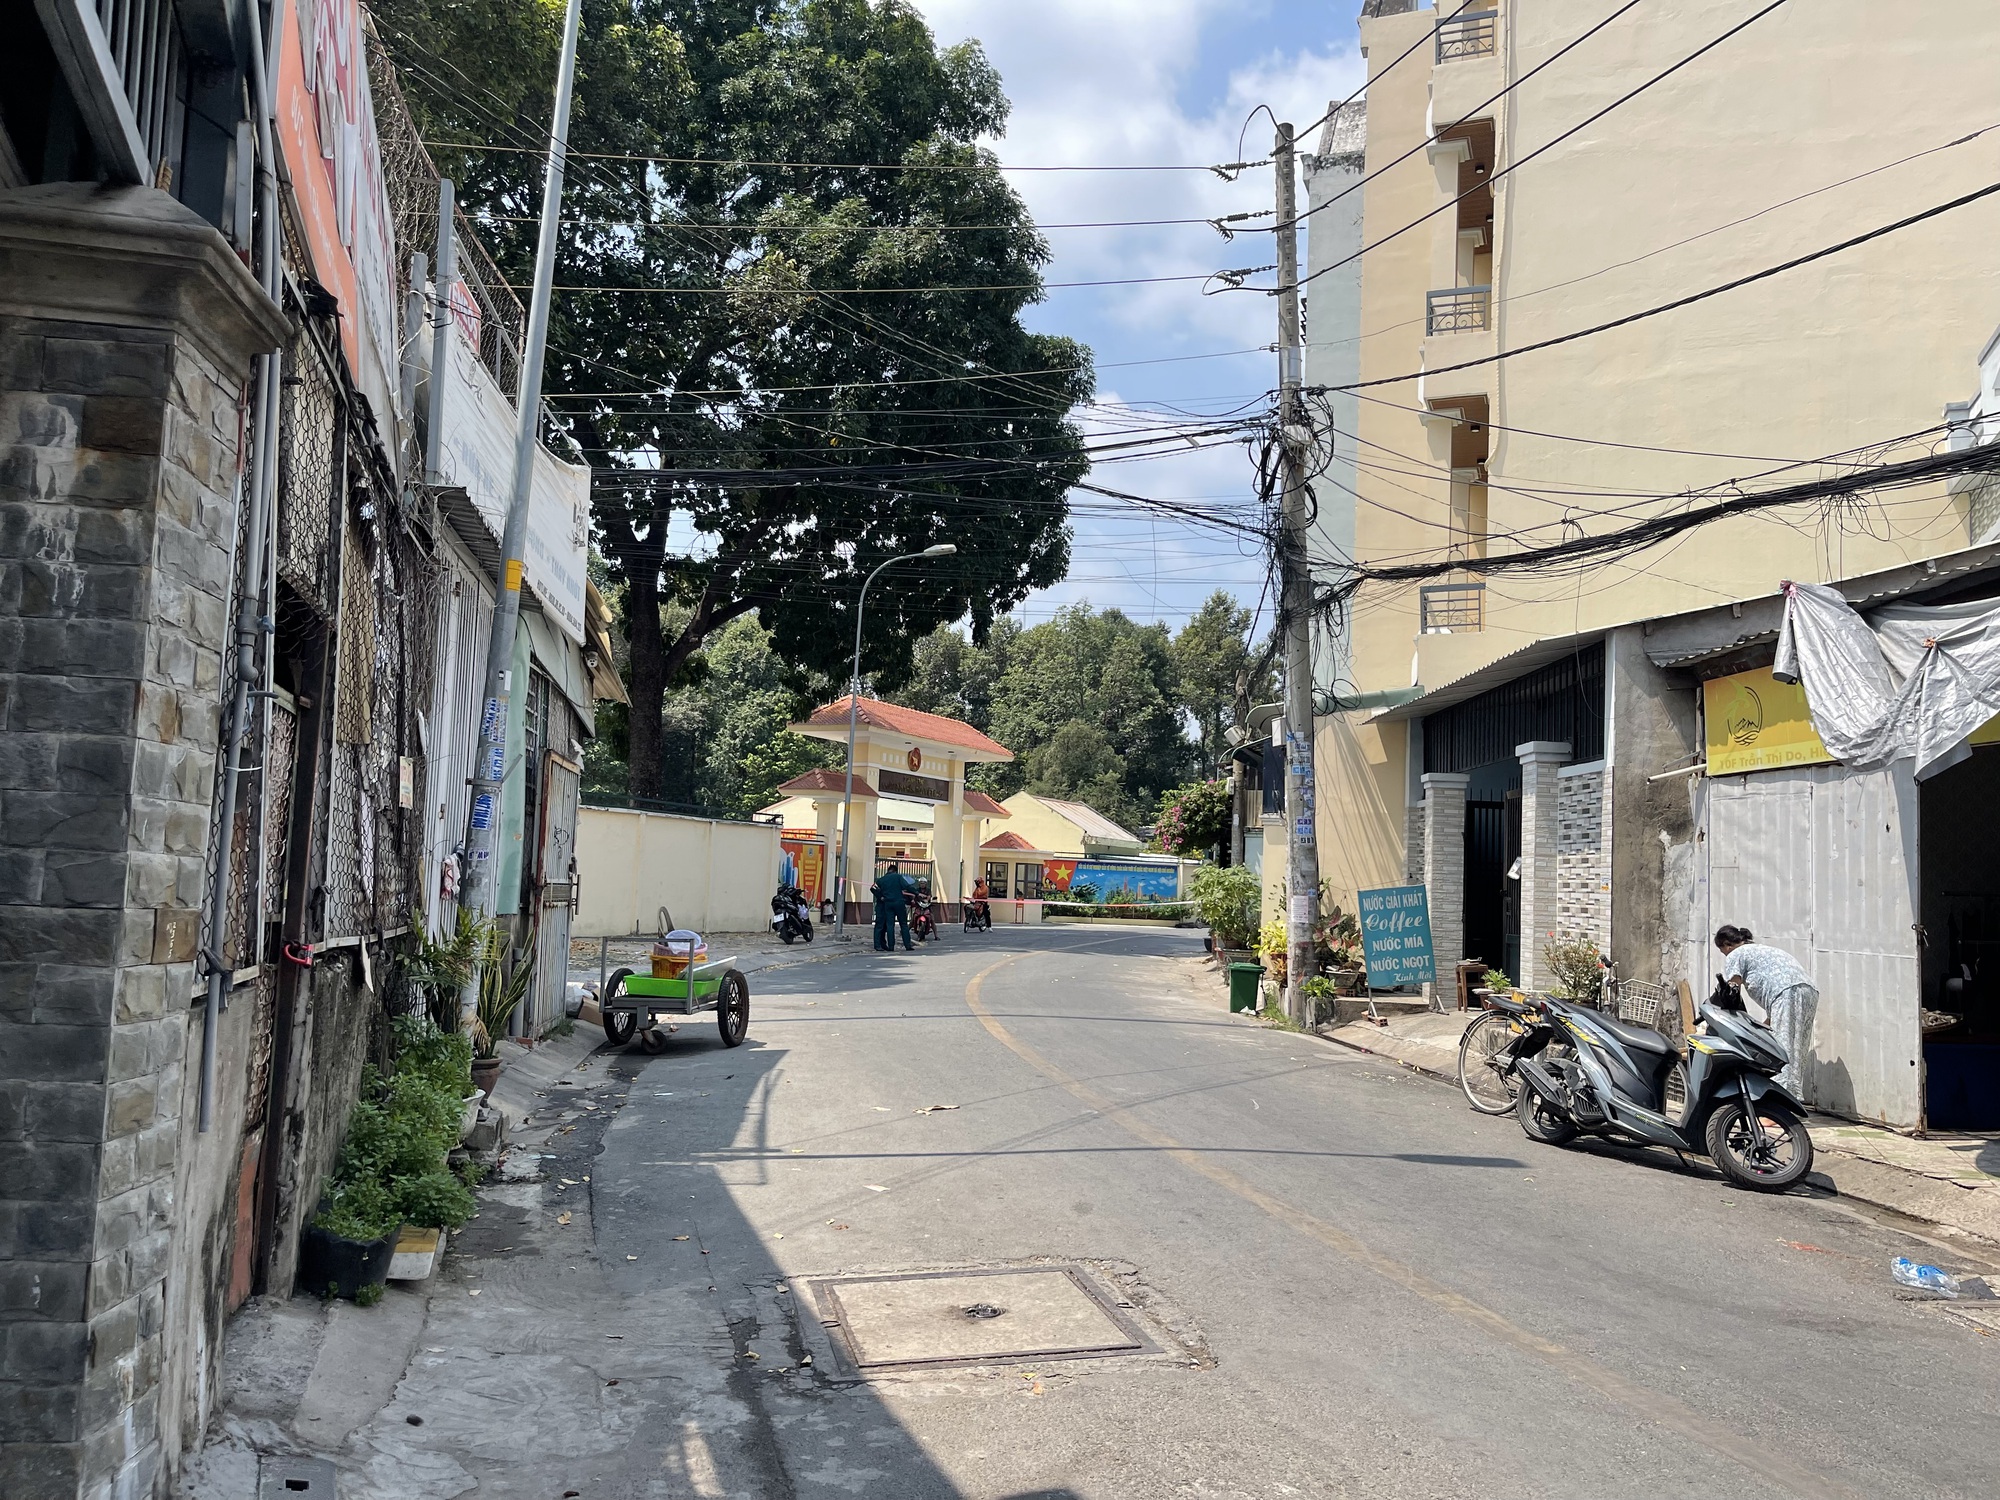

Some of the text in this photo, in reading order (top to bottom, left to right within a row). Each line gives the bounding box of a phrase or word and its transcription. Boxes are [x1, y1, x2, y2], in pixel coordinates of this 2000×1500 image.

[1766, 752, 1782, 765] Thị
[1786, 751, 1806, 761] Do,
[1363, 890, 1422, 911] NƯỚC GIẢI KHÁT
[1364, 911, 1424, 932] Coffee
[1373, 934, 1424, 951] NƯỚC MÍA
[1371, 955, 1429, 972] NƯỚC NGỌT
